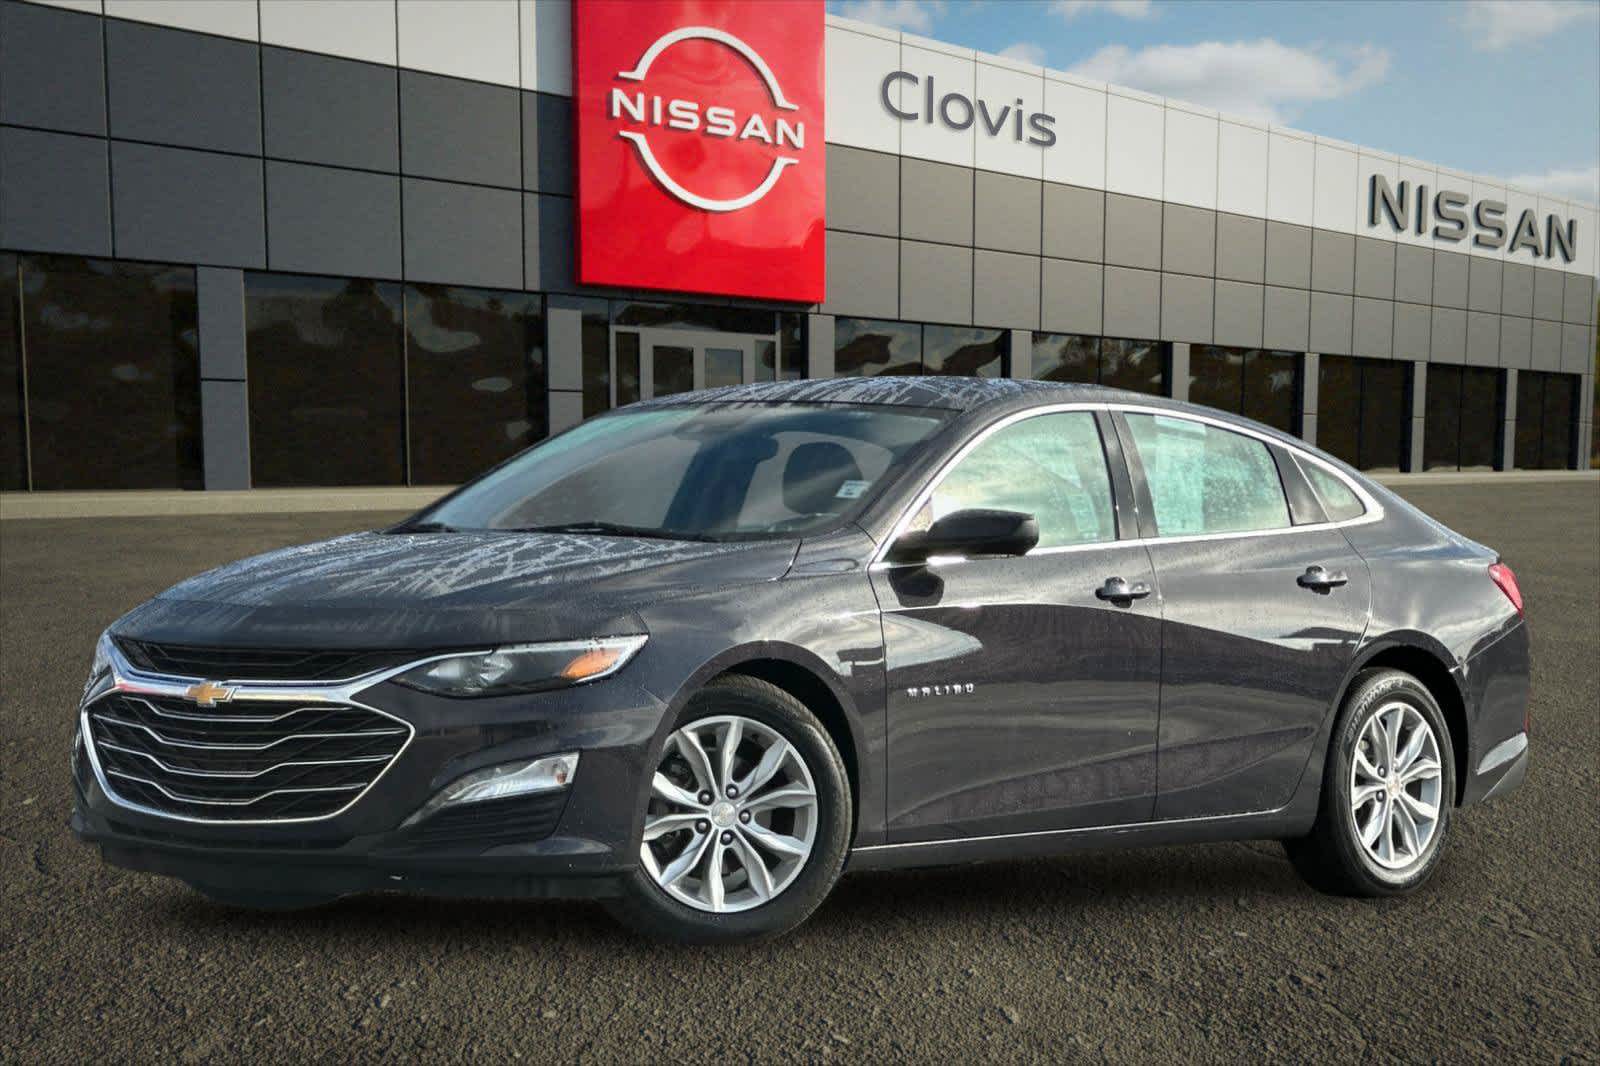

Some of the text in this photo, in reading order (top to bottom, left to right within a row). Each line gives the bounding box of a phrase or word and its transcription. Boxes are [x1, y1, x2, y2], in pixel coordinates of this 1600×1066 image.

[611, 88, 805, 149] NISSAN
[881, 71, 1057, 147] Clovis
[1369, 174, 1577, 262] NISSAN
